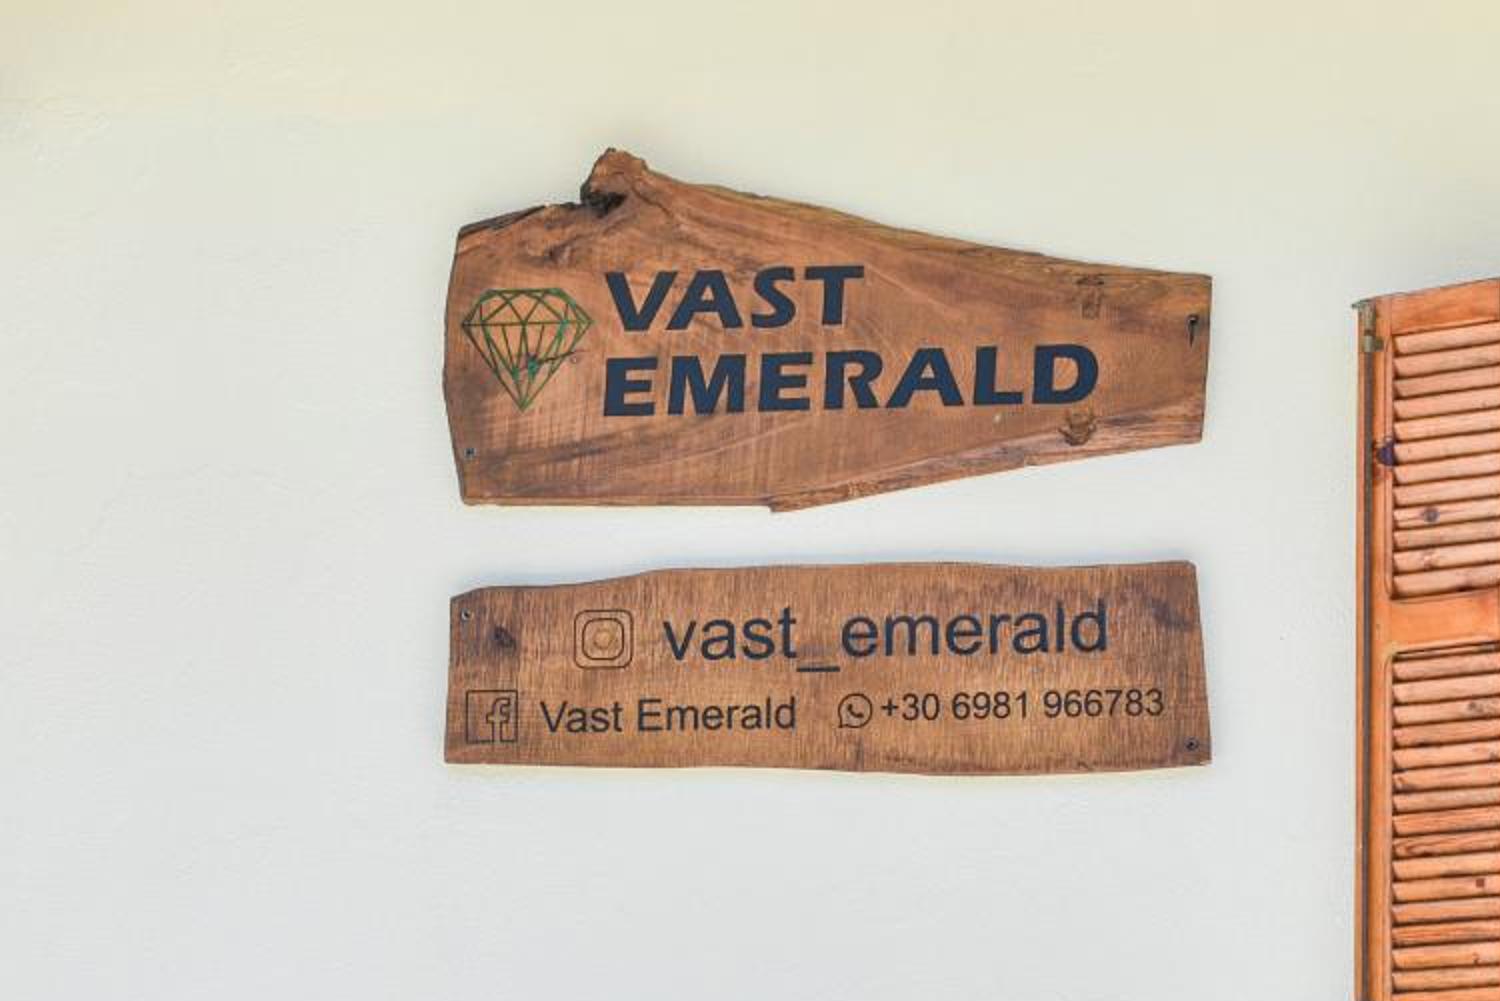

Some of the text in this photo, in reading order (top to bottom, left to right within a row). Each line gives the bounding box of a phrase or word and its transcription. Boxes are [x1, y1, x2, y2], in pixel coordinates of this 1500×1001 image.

[606, 265, 864, 331] VAST
[603, 344, 1099, 417] EMERALD
[663, 600, 1108, 673] vast_emerald
[539, 696, 797, 733] Vast Emerald
[880, 688, 1166, 723] +30 6981 966783
